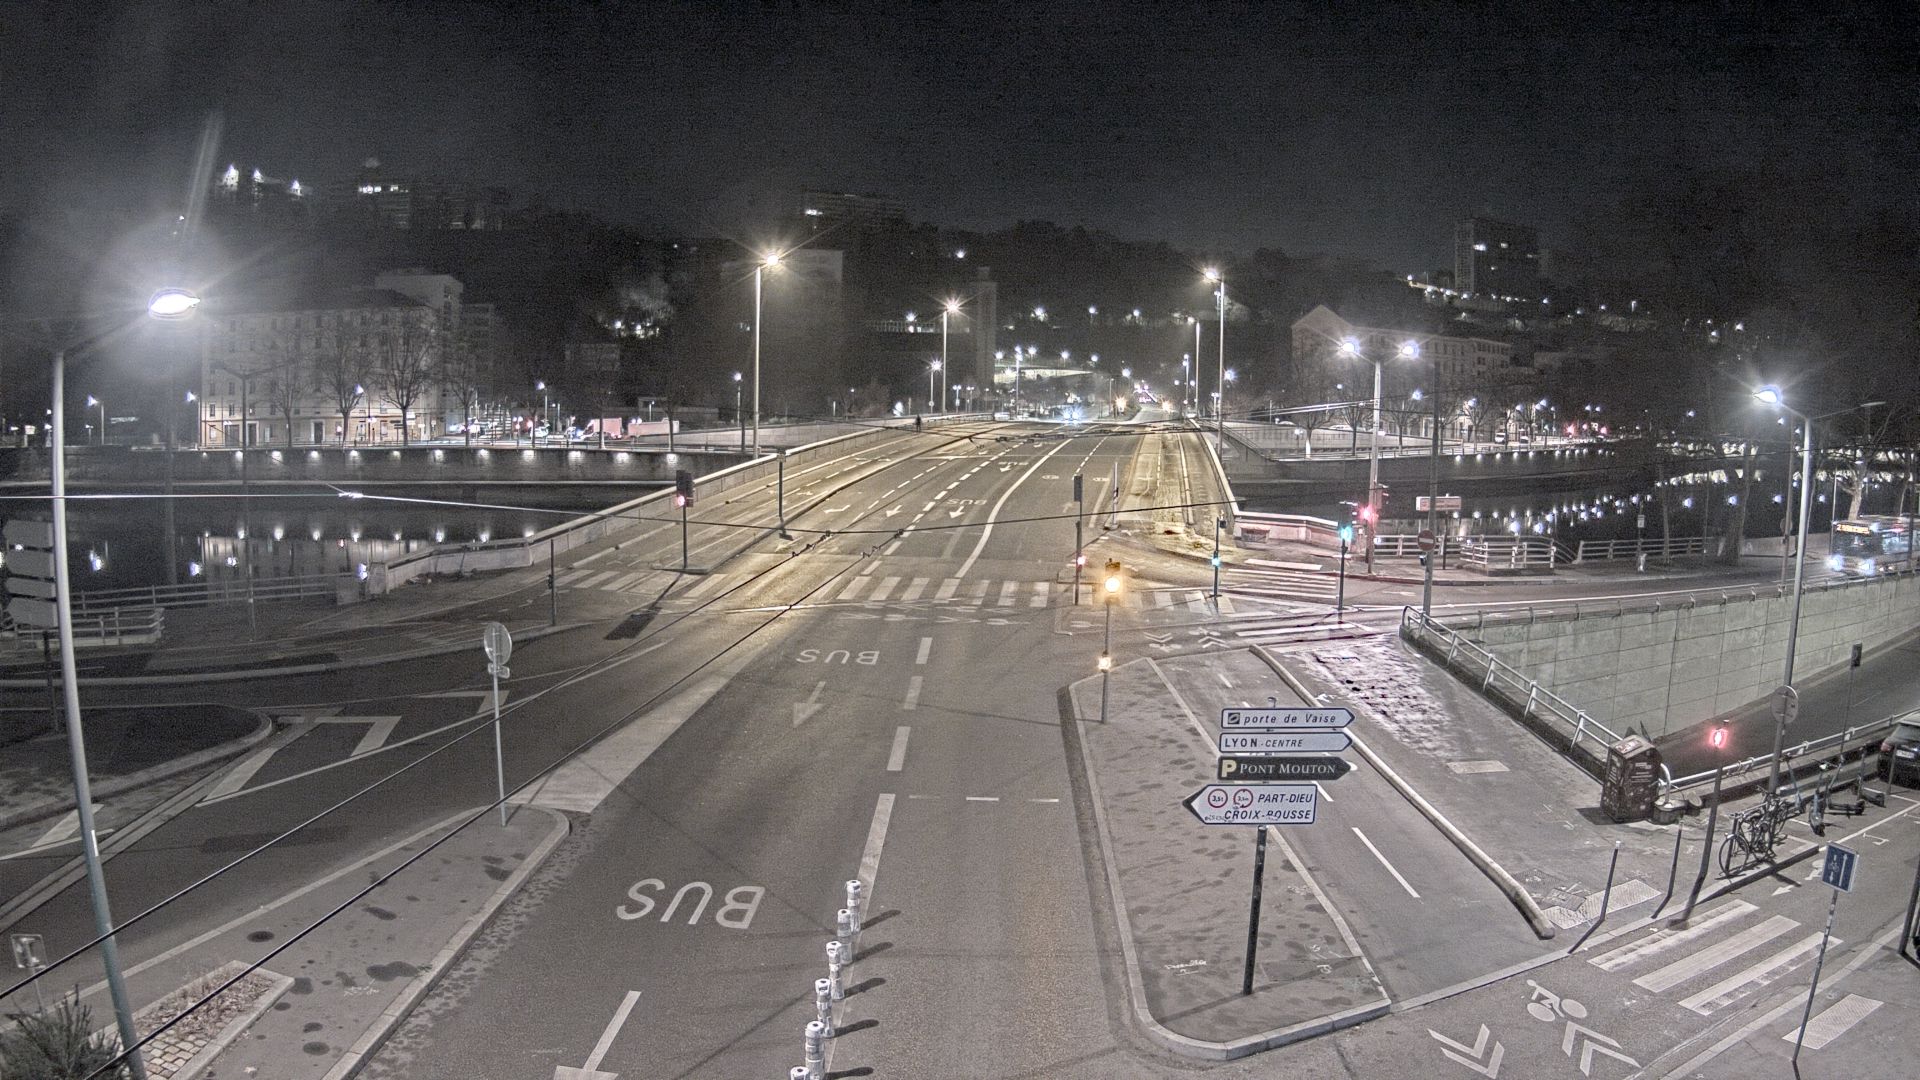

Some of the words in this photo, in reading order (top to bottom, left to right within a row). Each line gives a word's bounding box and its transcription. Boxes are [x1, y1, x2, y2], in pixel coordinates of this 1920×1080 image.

[795, 648, 880, 665] BUS
[1243, 715, 1277, 725] porte
[1283, 713, 1298, 724] de
[1305, 713, 1337, 724] Vaise
[1221, 759, 1237, 778] P
[1257, 793, 1314, 803] PART-DIEU
[616, 878, 766, 930] BUS
